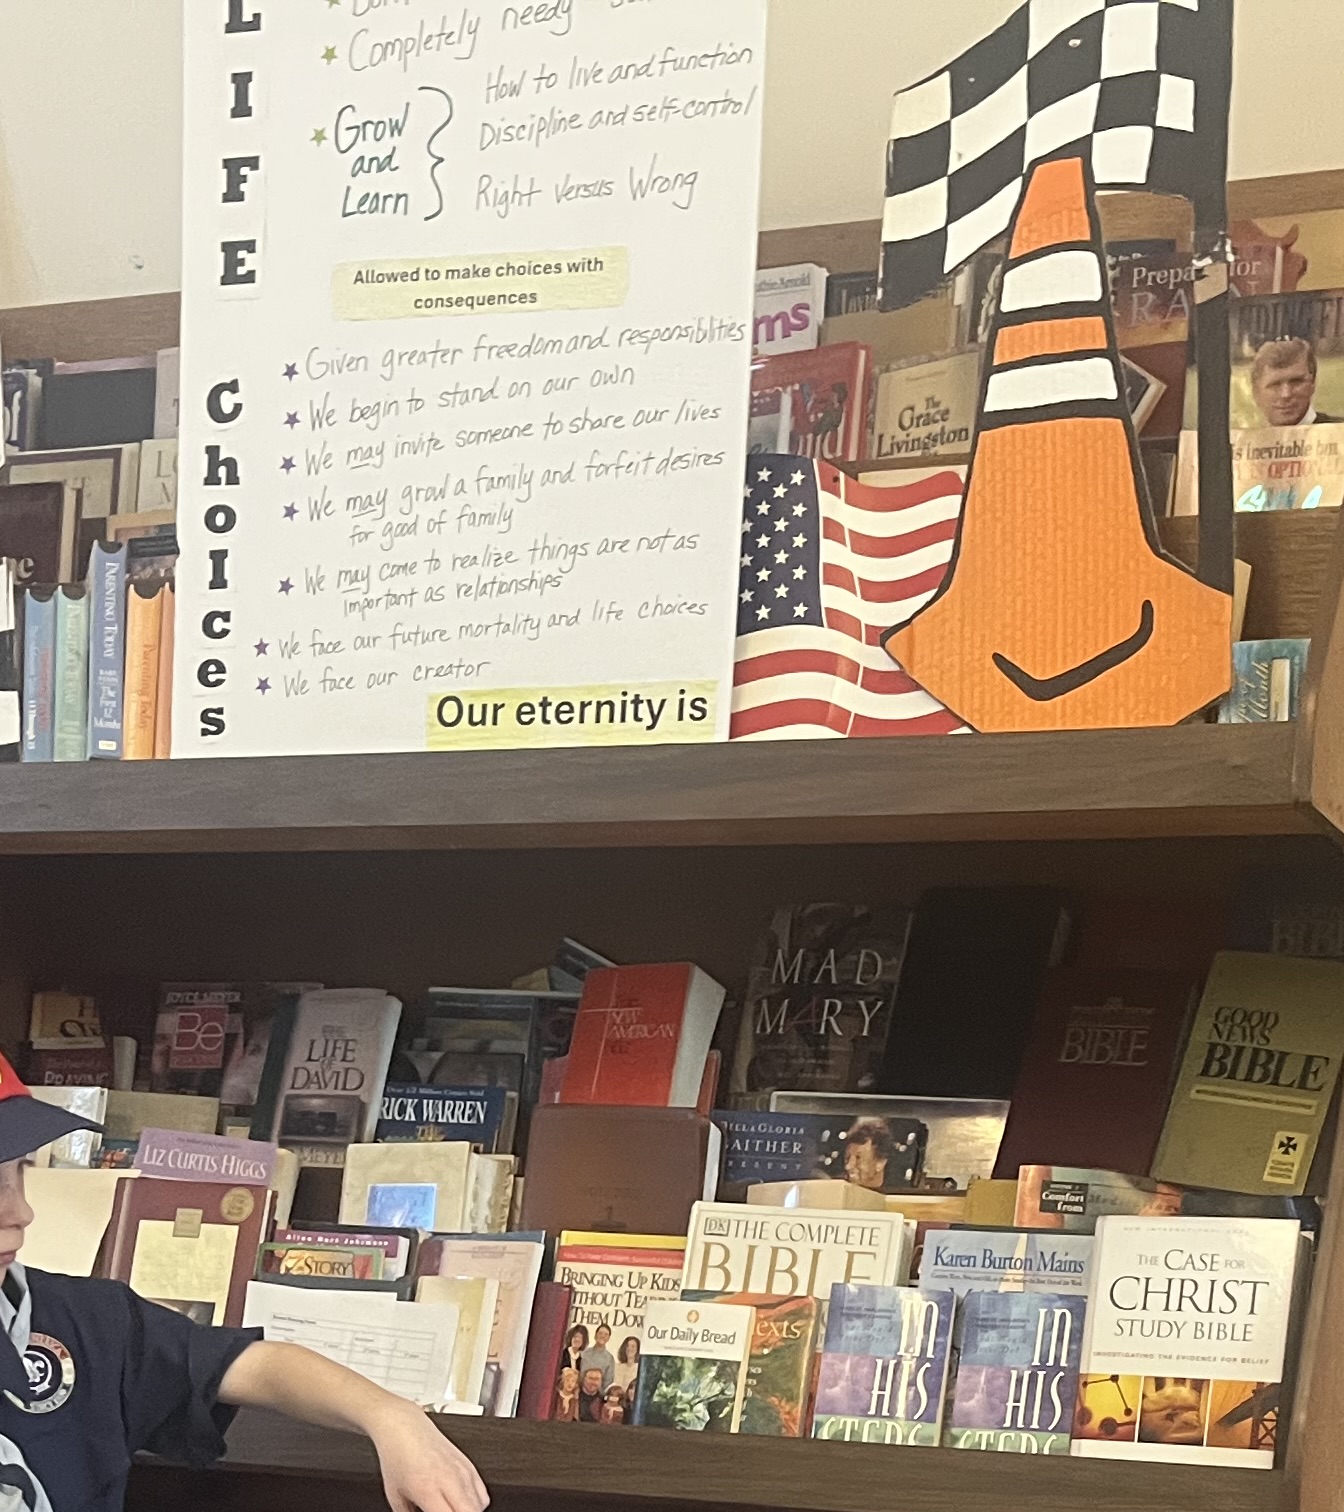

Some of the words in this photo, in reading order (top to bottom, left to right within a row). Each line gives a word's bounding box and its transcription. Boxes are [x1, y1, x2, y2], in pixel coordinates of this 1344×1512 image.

[349, 8, 480, 72] Completely
[502, 0, 573, 36] needy
[485, 65, 526, 104] How
[533, 64, 558, 94] to
[568, 55, 603, 89] live
[608, 54, 656, 84] and
[658, 43, 752, 76] function
[335, 102, 410, 154] Grow
[480, 107, 582, 151] Discipline
[588, 104, 629, 130] and
[351, 146, 399, 177] and
[342, 186, 409, 218] Learn
[476, 175, 542, 218] Right
[629, 153, 698, 210] Wrong
[353, 267, 419, 285] Allowed
[425, 267, 441, 281] to
[445, 264, 491, 280] make
[495, 262, 562, 277] choices
[567, 257, 604, 273] with
[413, 291, 538, 310] consequences
[306, 347, 368, 380] Given
[380, 339, 463, 381] greater
[473, 334, 562, 361] freedom
[565, 326, 609, 350] and
[309, 392, 337, 431] We
[349, 393, 398, 430] begin
[407, 388, 424, 416] to
[438, 376, 499, 408] stand
[508, 381, 531, 399] on
[542, 375, 580, 395] our
[590, 365, 634, 387] own
[897, 403, 950, 432] Grace
[306, 440, 333, 476] We
[346, 441, 385, 469] may
[394, 433, 445, 458] invite
[455, 422, 534, 447] someone
[543, 411, 564, 440] to
[568, 407, 626, 434] share
[632, 407, 669, 427] our
[674, 398, 722, 425] lives
[877, 425, 969, 457] Livingston
[308, 485, 336, 522] We
[346, 487, 388, 521] may
[399, 473, 450, 515] grow
[454, 476, 467, 496] a
[475, 462, 534, 502] family
[540, 461, 575, 487] and
[584, 448, 654, 482] forfeit
[655, 446, 726, 476] desires
[349, 524, 375, 548] for
[380, 514, 417, 551] good
[427, 510, 447, 535] of
[457, 502, 513, 534] family
[305, 565, 325, 595] We
[336, 565, 371, 594] may
[379, 560, 417, 582] come
[424, 549, 441, 575] to
[452, 544, 519, 575] realize
[528, 532, 591, 574] things
[596, 538, 631, 556] are
[636, 528, 676, 552] not
[674, 533, 700, 551] as
[424, 586, 445, 602] as
[457, 569, 564, 600] relationships
[279, 631, 301, 659] We
[309, 628, 345, 657] face
[353, 633, 382, 651] our
[389, 621, 451, 650] future
[459, 613, 541, 641] mortality
[547, 608, 581, 627] and
[592, 599, 624, 621] life
[284, 670, 310, 698] We
[320, 666, 356, 693] face
[366, 670, 398, 689] our
[412, 658, 491, 681] creator
[436, 695, 505, 727] Our
[515, 690, 667, 731] eternity
[677, 688, 707, 722] is
[771, 948, 883, 985] MAD
[174, 1012, 225, 1050] Be
[756, 996, 884, 1037] MARY
[1210, 1023, 1273, 1046] NEWS
[1214, 1006, 1280, 1030] GOOD
[306, 1038, 357, 1063] LIFE
[1199, 1041, 1330, 1092] BIBLE
[290, 1067, 365, 1092] DAVID
[379, 1096, 419, 1122] RICK
[422, 1098, 488, 1124] WARREN
[143, 1144, 165, 1167] LIZ
[168, 1148, 218, 1174] CURTIS
[220, 1153, 267, 1179] HIGGS
[724, 1138, 802, 1154] AITHER
[1042, 1190, 1084, 1203] Comfort
[1056, 1201, 1083, 1213] from
[706, 1218, 727, 1234] DK
[728, 1218, 770, 1240] THE
[775, 1221, 881, 1247] COMPLETE
[303, 1256, 354, 1277] STORY
[933, 1245, 977, 1269] Karen
[981, 1248, 1033, 1272] Burton
[1036, 1251, 1085, 1274] Mains
[1137, 1254, 1159, 1266] THE
[1164, 1249, 1221, 1272] CASE
[561, 1267, 623, 1289] BRINGING
[649, 1272, 681, 1292] KIDS
[1109, 1275, 1270, 1316] CHRIST
[647, 1326, 667, 1340] Our
[670, 1326, 699, 1345] Daily
[701, 1329, 737, 1345] Bread
[896, 1299, 940, 1359] IN
[1031, 1308, 1073, 1367] IN
[1114, 1318, 1187, 1339] STUDY
[1193, 1321, 1254, 1342] BIBLE
[867, 1356, 932, 1421] HIS
[1003, 1370, 1065, 1431] HIS
